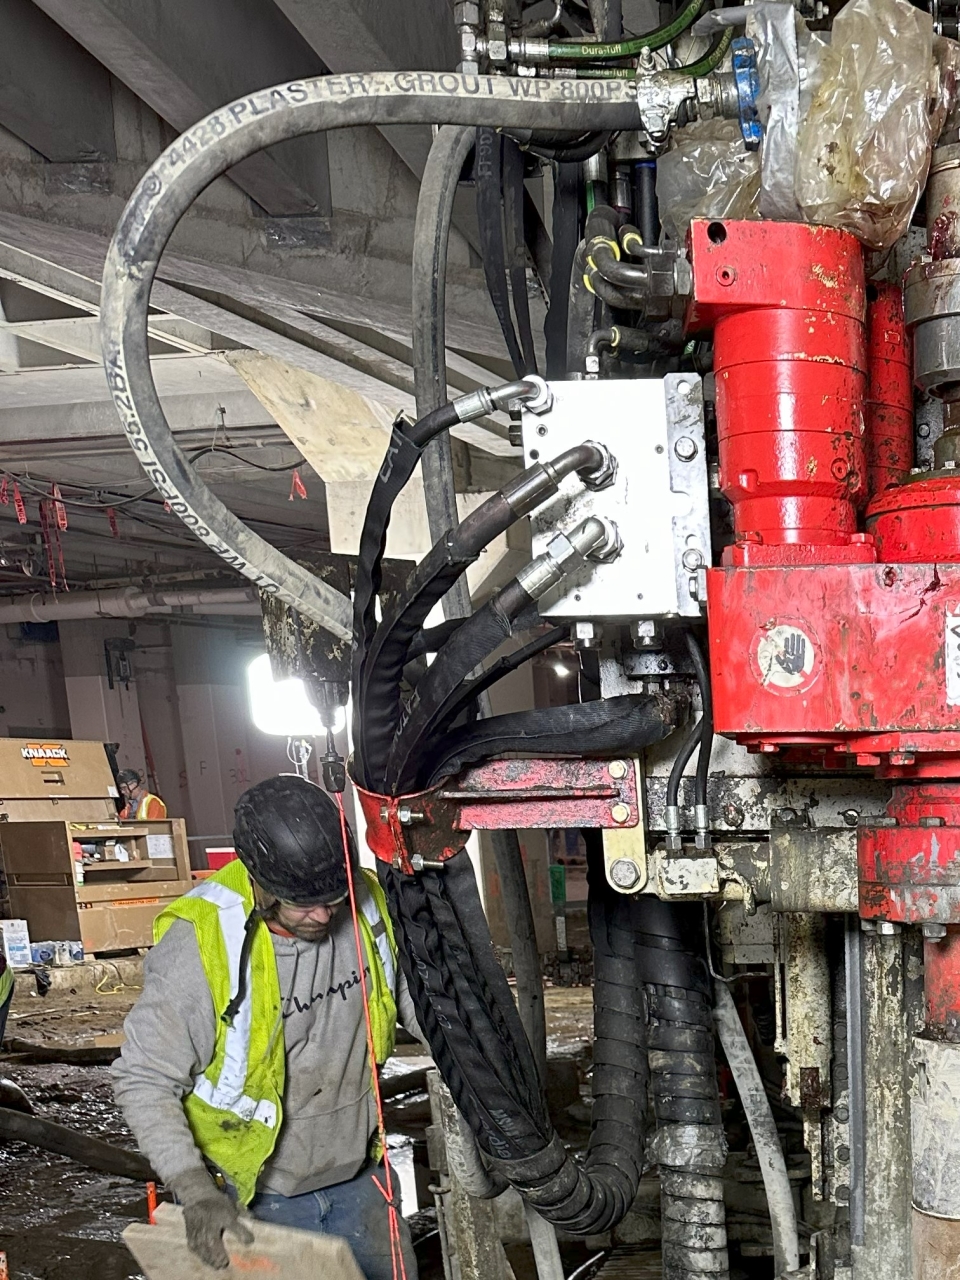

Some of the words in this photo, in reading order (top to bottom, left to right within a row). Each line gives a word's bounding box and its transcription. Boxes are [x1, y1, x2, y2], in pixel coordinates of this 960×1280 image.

[581, 44, 622, 55] Dura-Tuff
[168, 116, 227, 168] 4428
[229, 74, 368, 124] PLASTER
[394, 73, 498, 95] GROUT
[509, 77, 551, 98] WP
[21, 748, 67, 759] KNAACK
